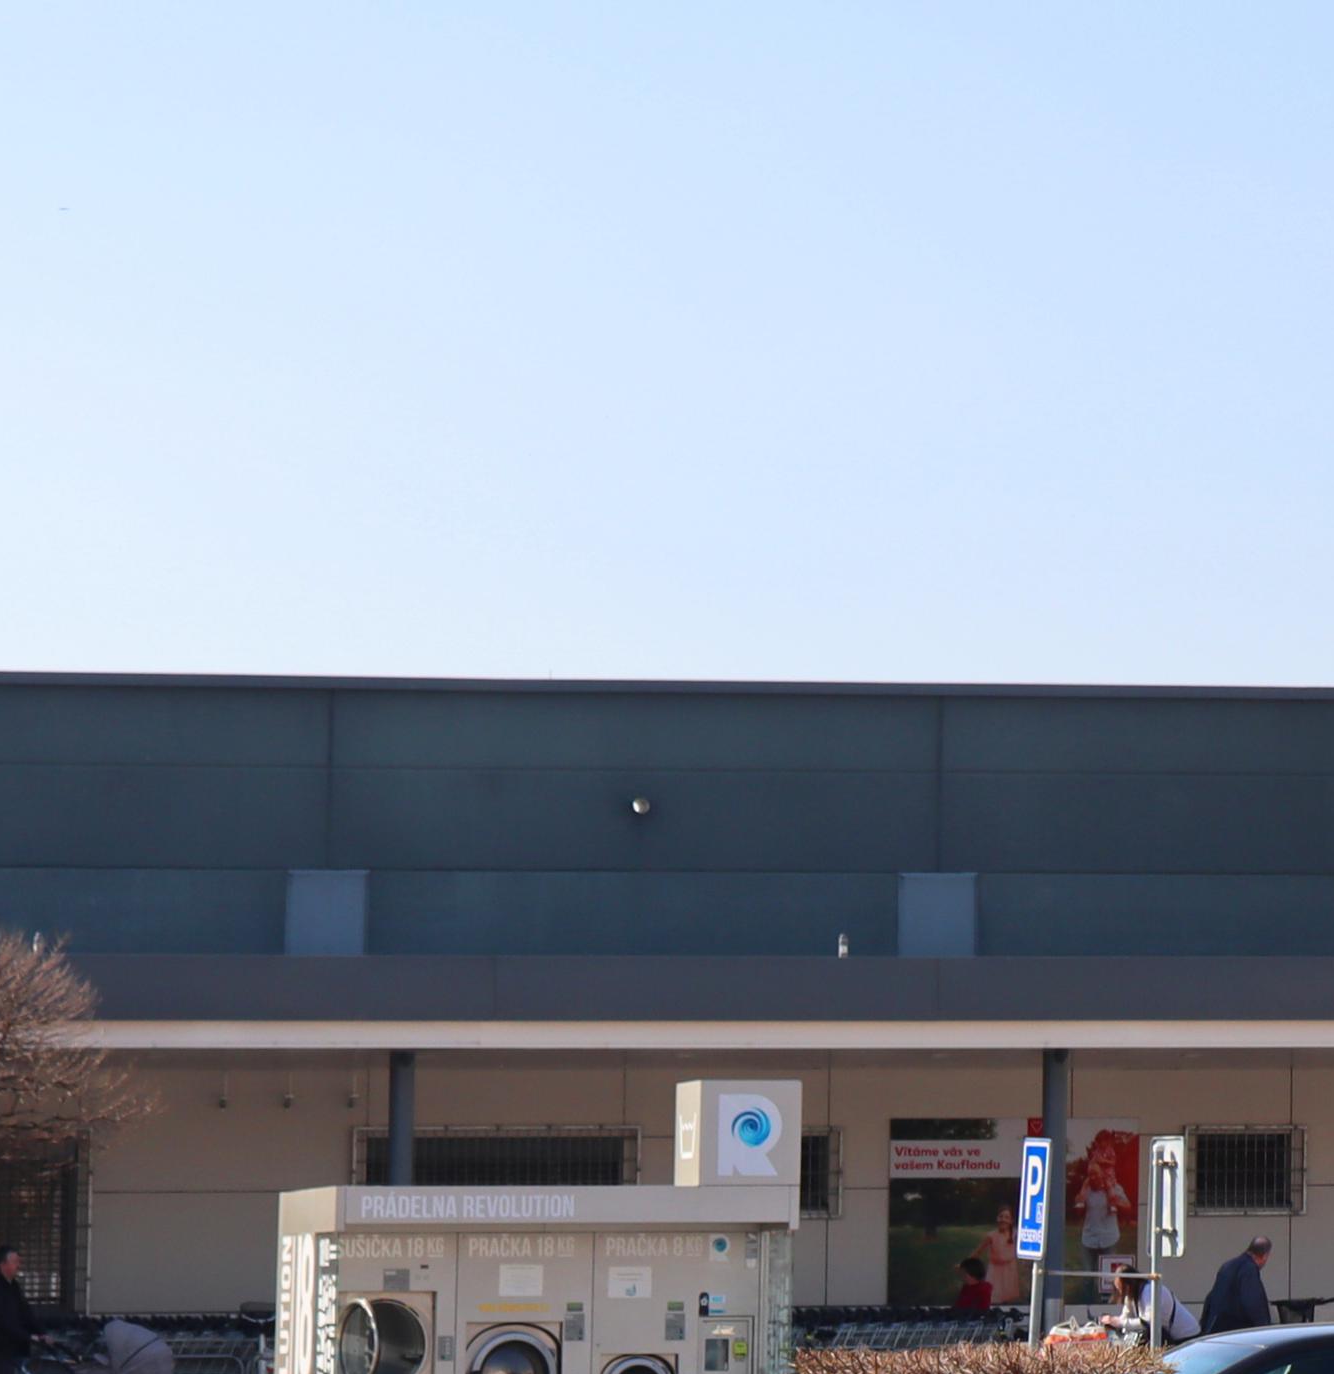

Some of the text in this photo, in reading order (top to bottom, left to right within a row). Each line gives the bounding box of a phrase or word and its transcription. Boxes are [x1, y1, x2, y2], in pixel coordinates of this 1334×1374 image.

[937, 1159, 1001, 1171] Kauflandu
[967, 1149, 981, 1157] ve
[1025, 1155, 1043, 1220] P
[361, 1193, 575, 1219] PRÁDELNA REVOLUTION
[338, 1233, 445, 1258] SUŠIČKA 18 KG
[469, 1233, 576, 1257] PRAČKA 18 KG
[606, 1233, 704, 1257] PRAČKA 8 KG
